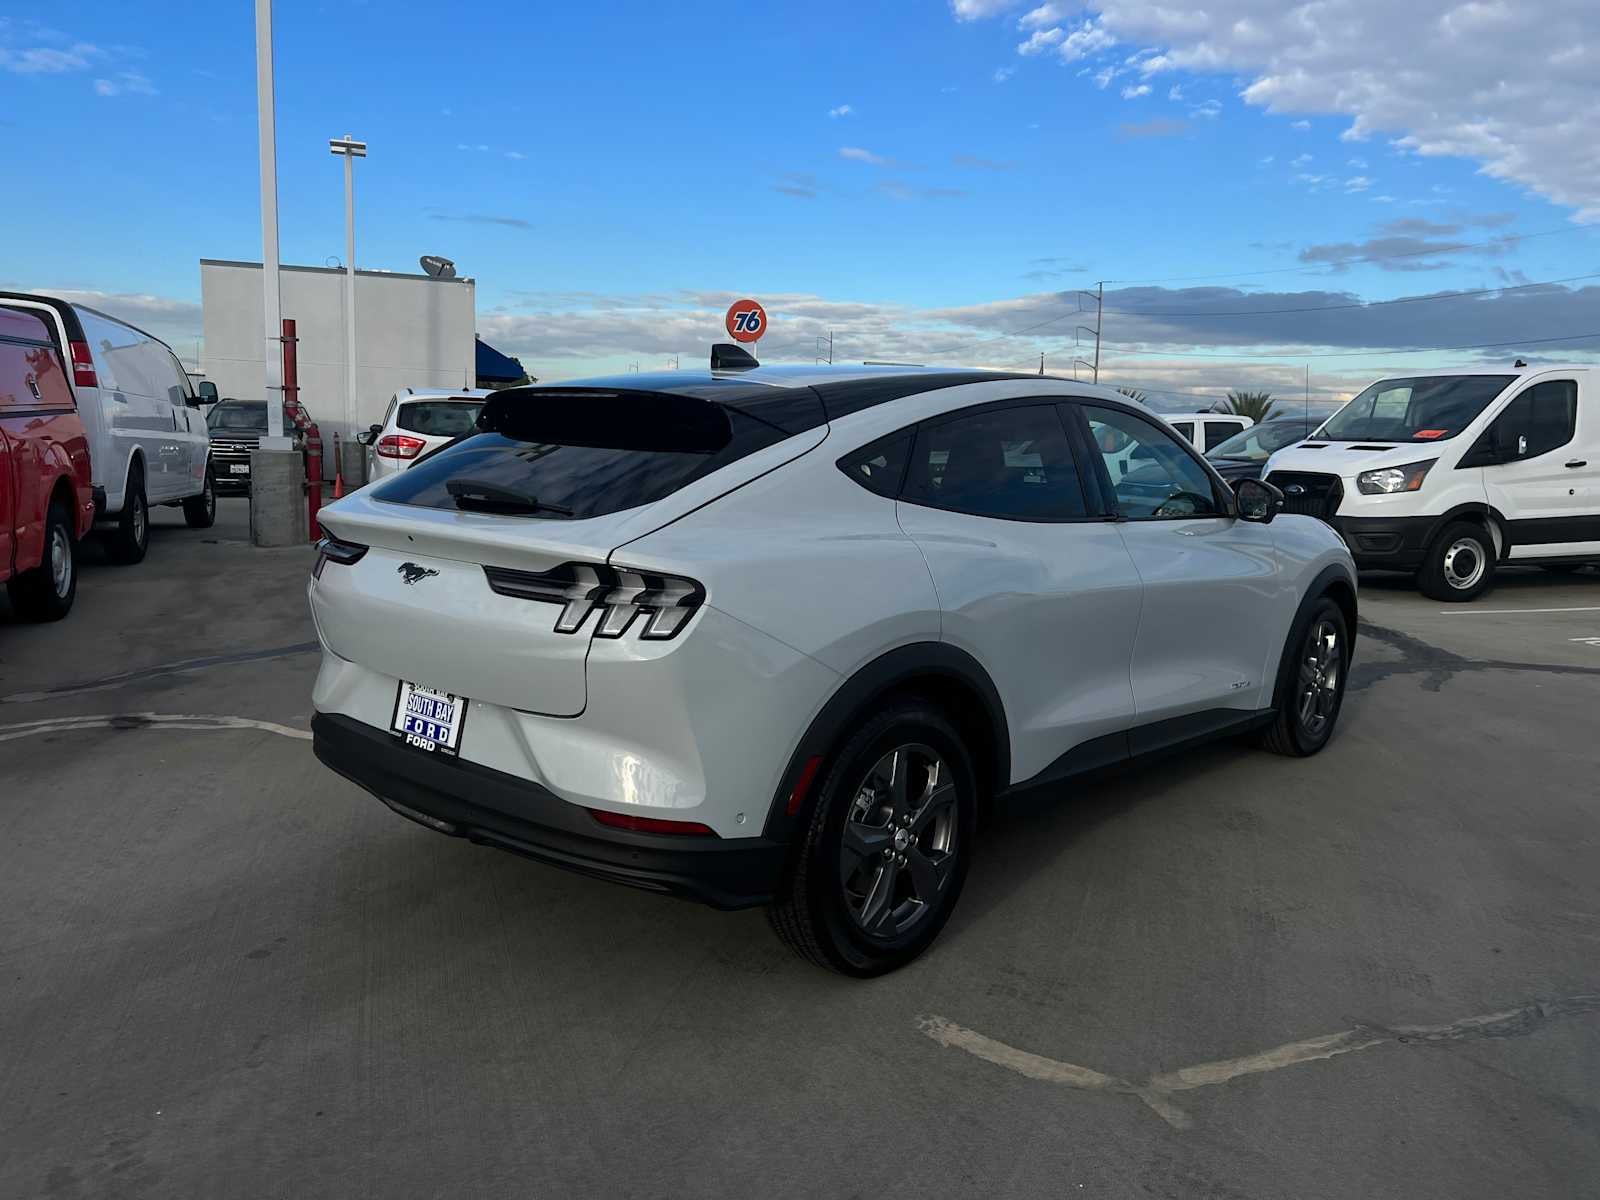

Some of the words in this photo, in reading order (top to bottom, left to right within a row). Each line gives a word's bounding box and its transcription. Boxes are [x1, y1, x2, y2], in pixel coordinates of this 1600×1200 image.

[733, 309, 761, 333] 76
[408, 694, 434, 716] SOUTH
[435, 702, 454, 723] BAY
[404, 716, 448, 742] FORD
[406, 734, 435, 752] FORD
